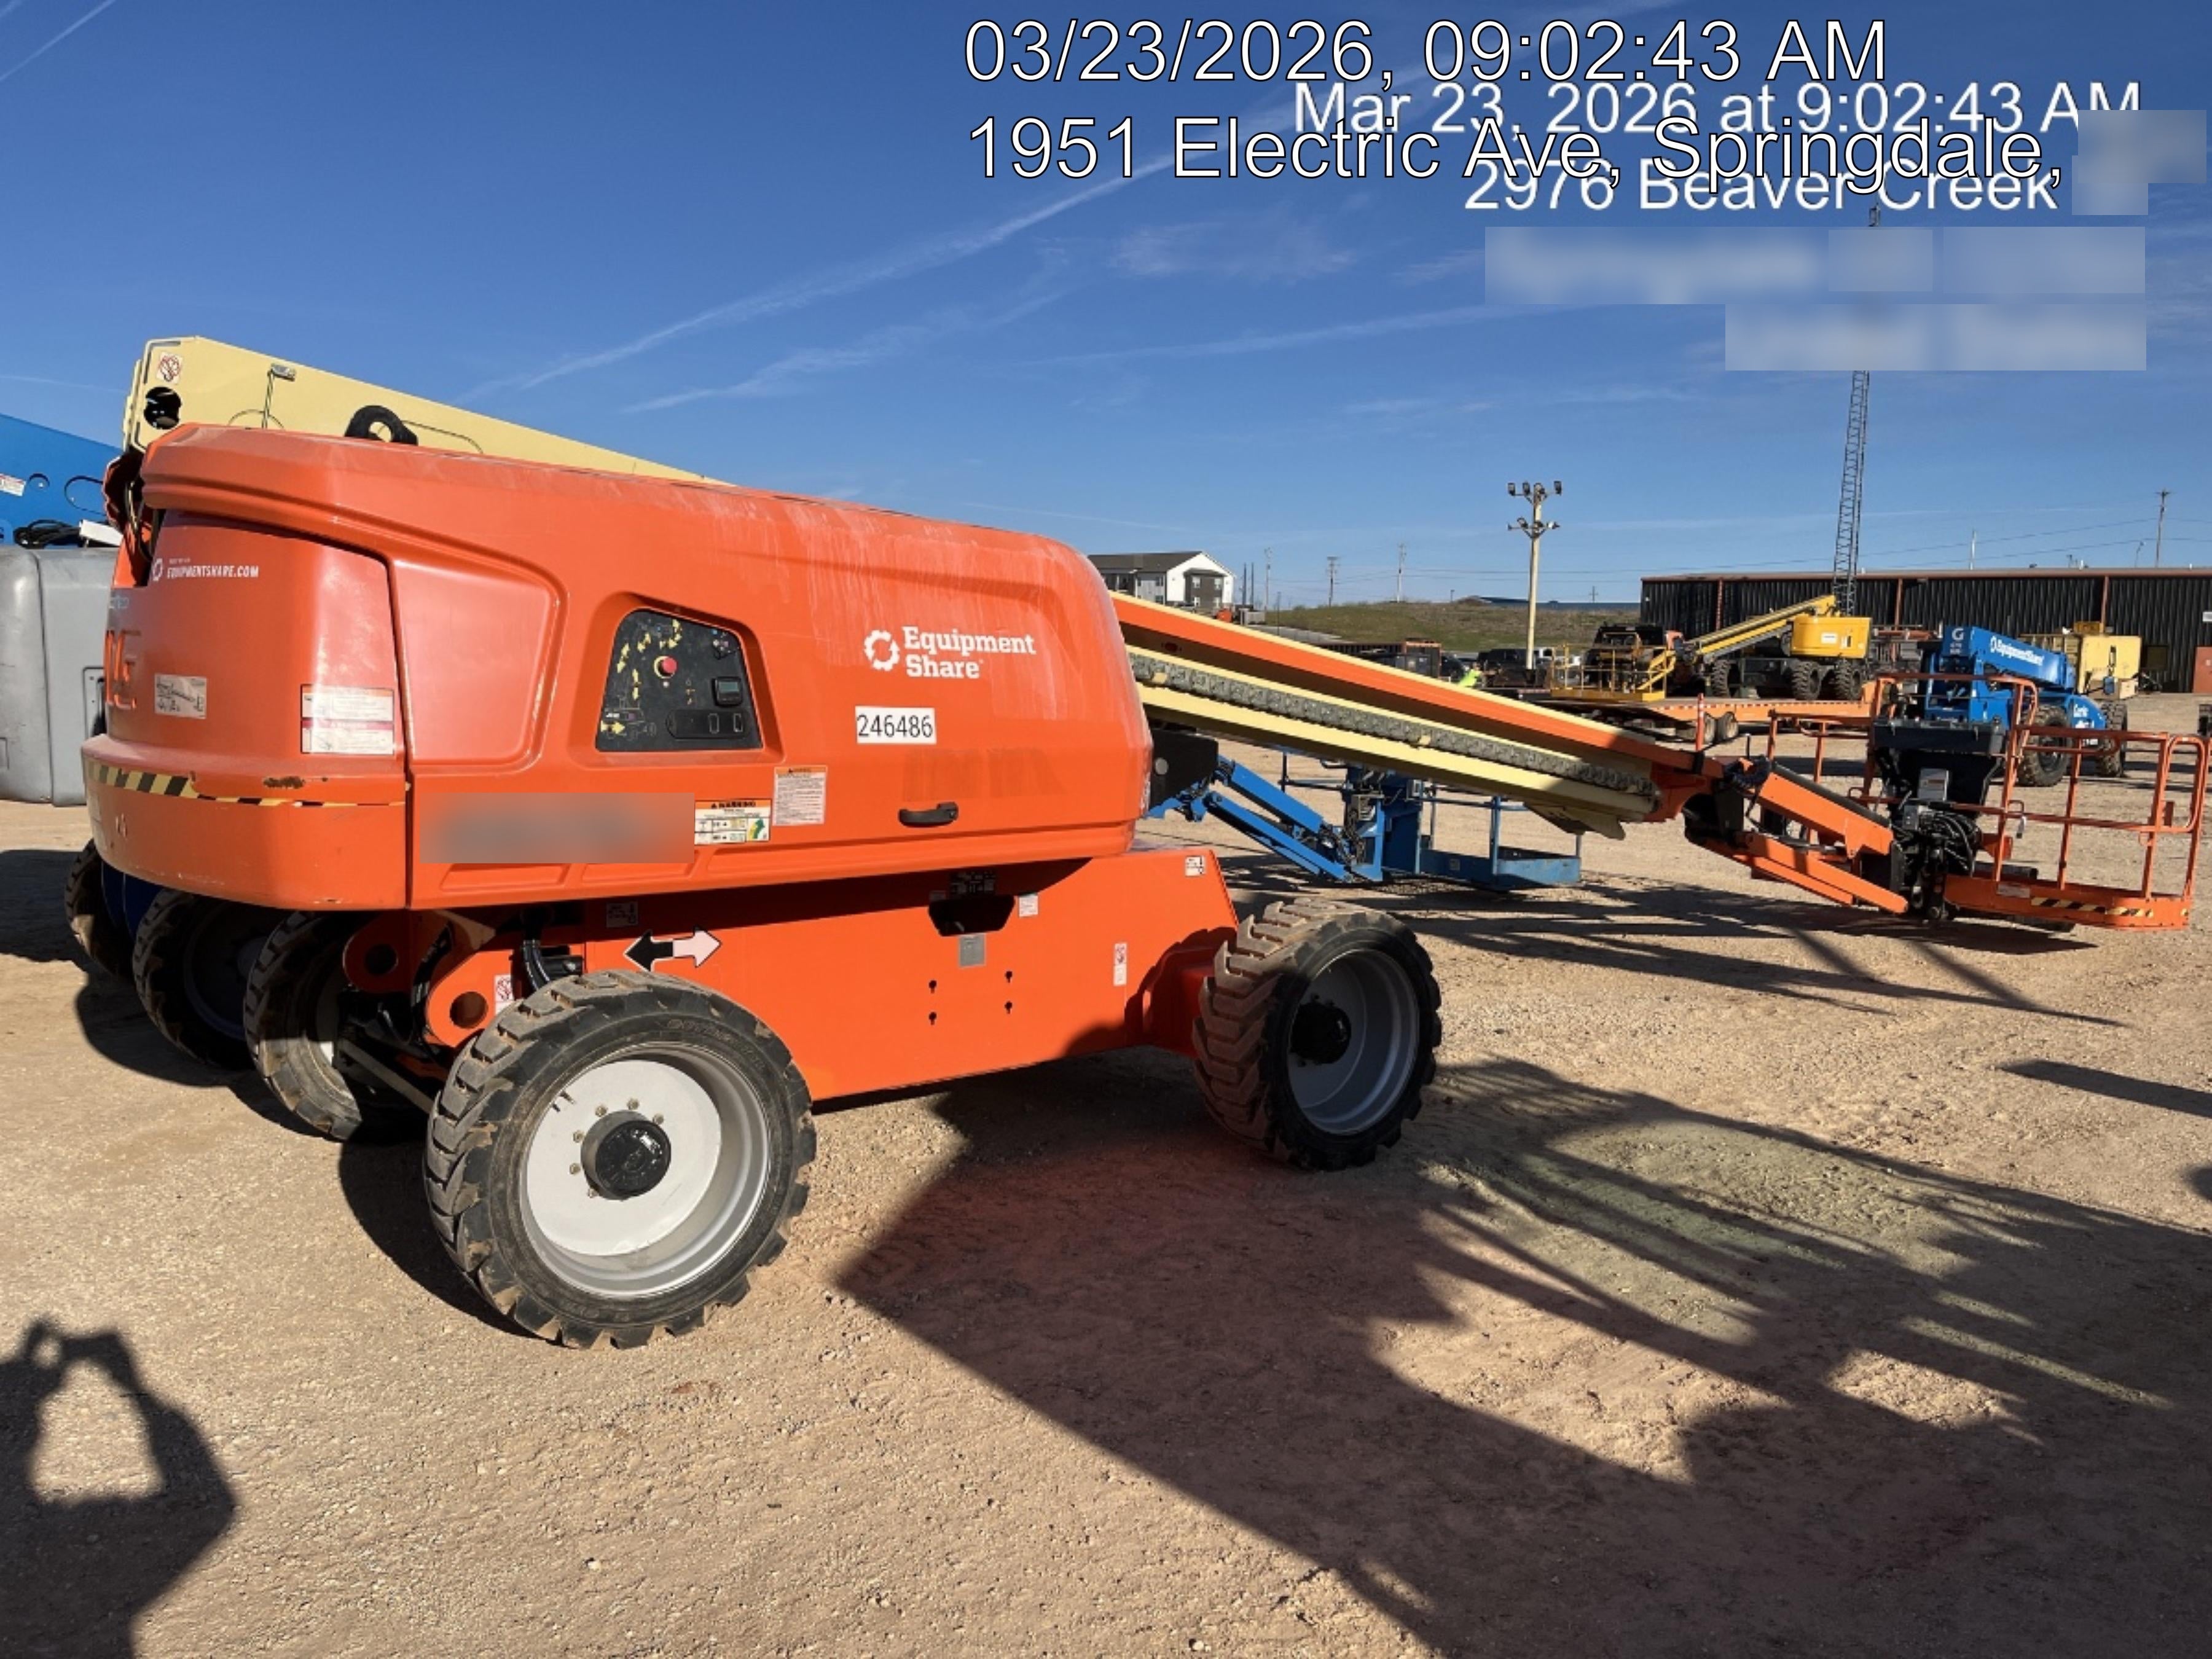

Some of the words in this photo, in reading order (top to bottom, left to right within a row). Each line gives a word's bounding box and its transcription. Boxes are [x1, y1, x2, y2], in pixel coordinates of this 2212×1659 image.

[902, 626, 1037, 657] Equipment
[906, 654, 980, 679] Share
[857, 714, 933, 738] 246486
